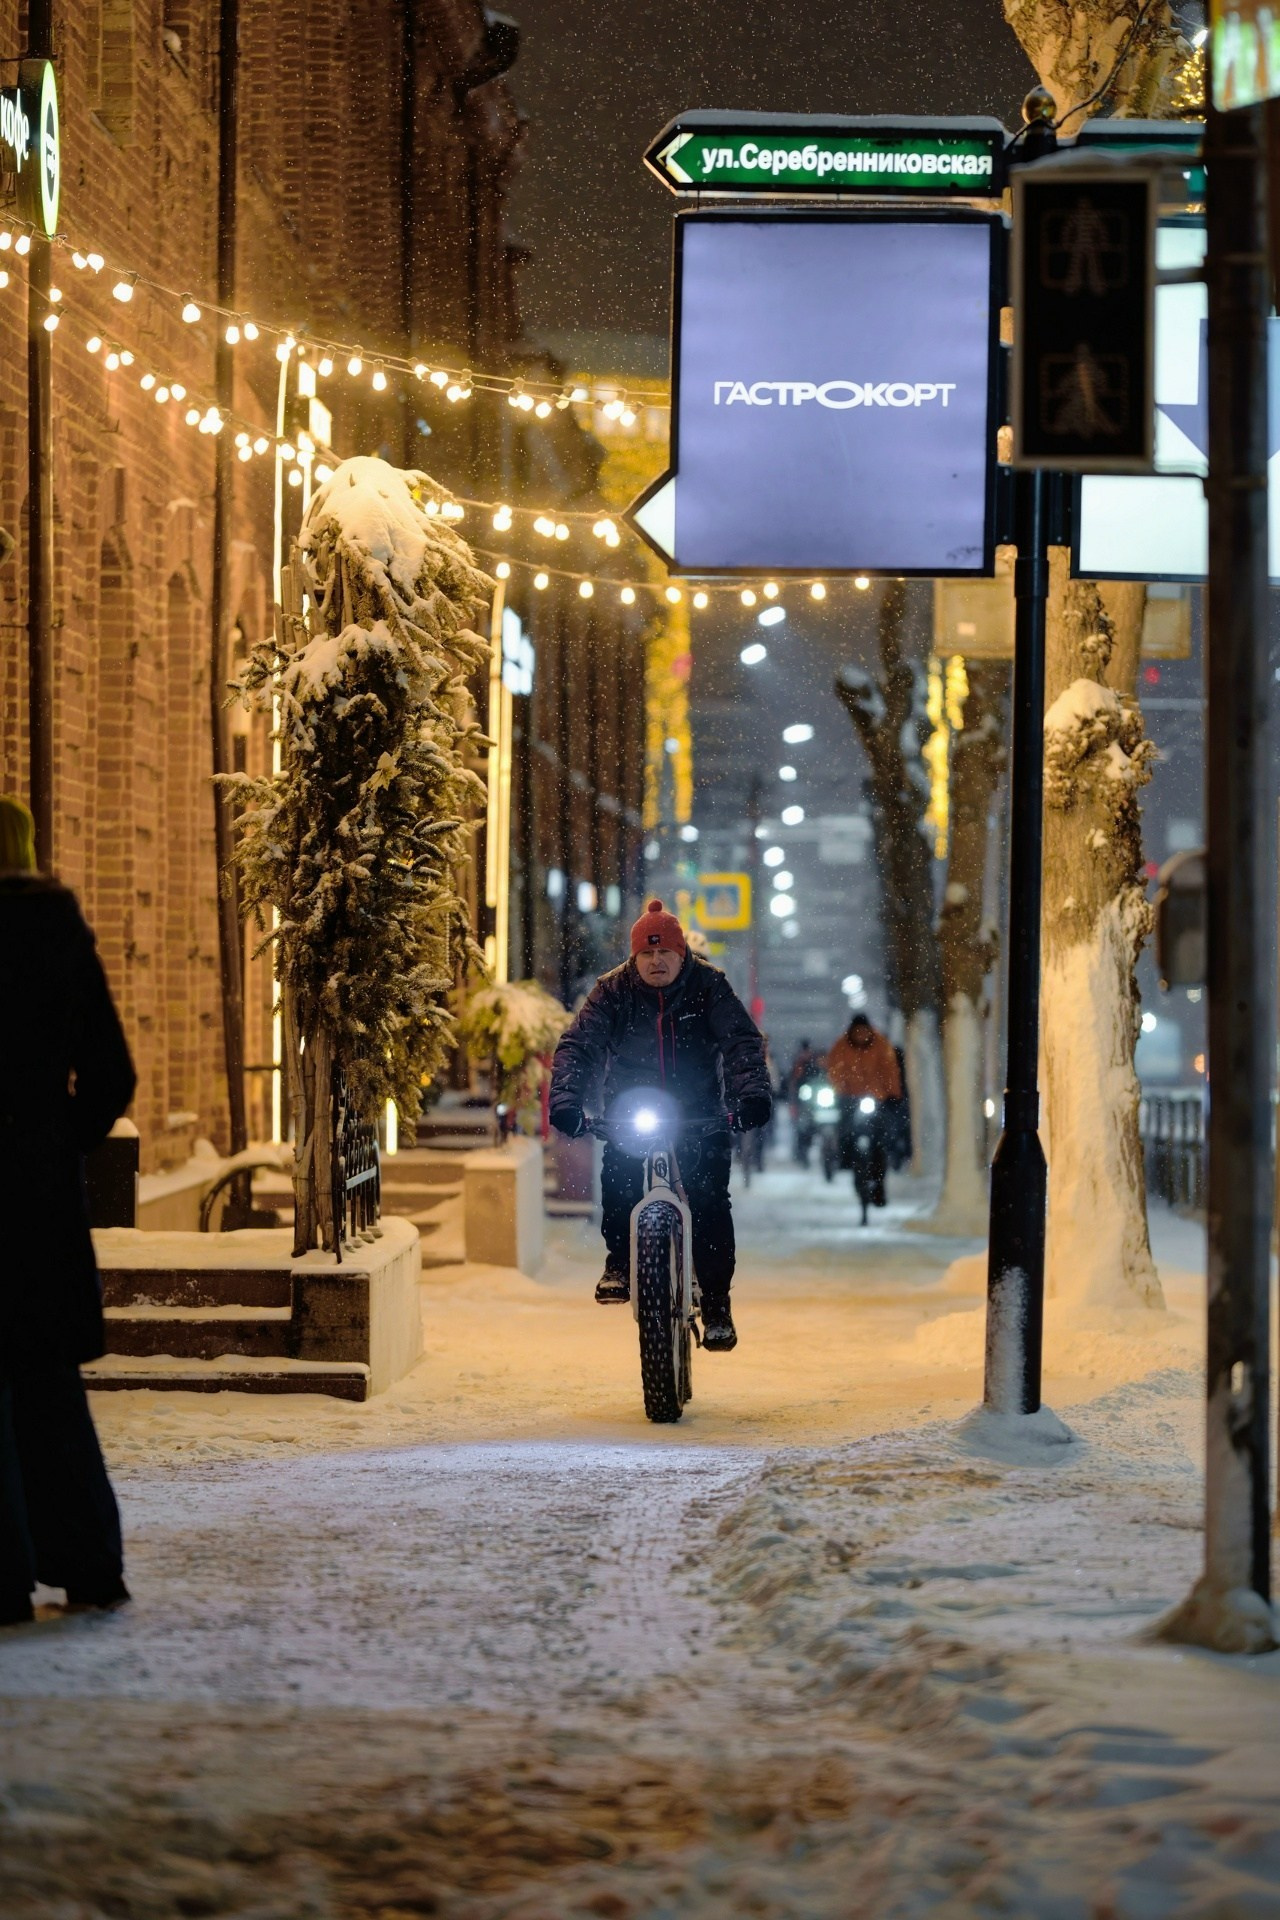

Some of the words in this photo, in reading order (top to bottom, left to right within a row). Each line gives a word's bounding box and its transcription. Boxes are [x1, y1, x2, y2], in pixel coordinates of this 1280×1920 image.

[1, 87, 30, 174] кофе
[702, 143, 992, 176] ул.Серебренниковская
[714, 380, 957, 409] ГАСТРОКОРТ
